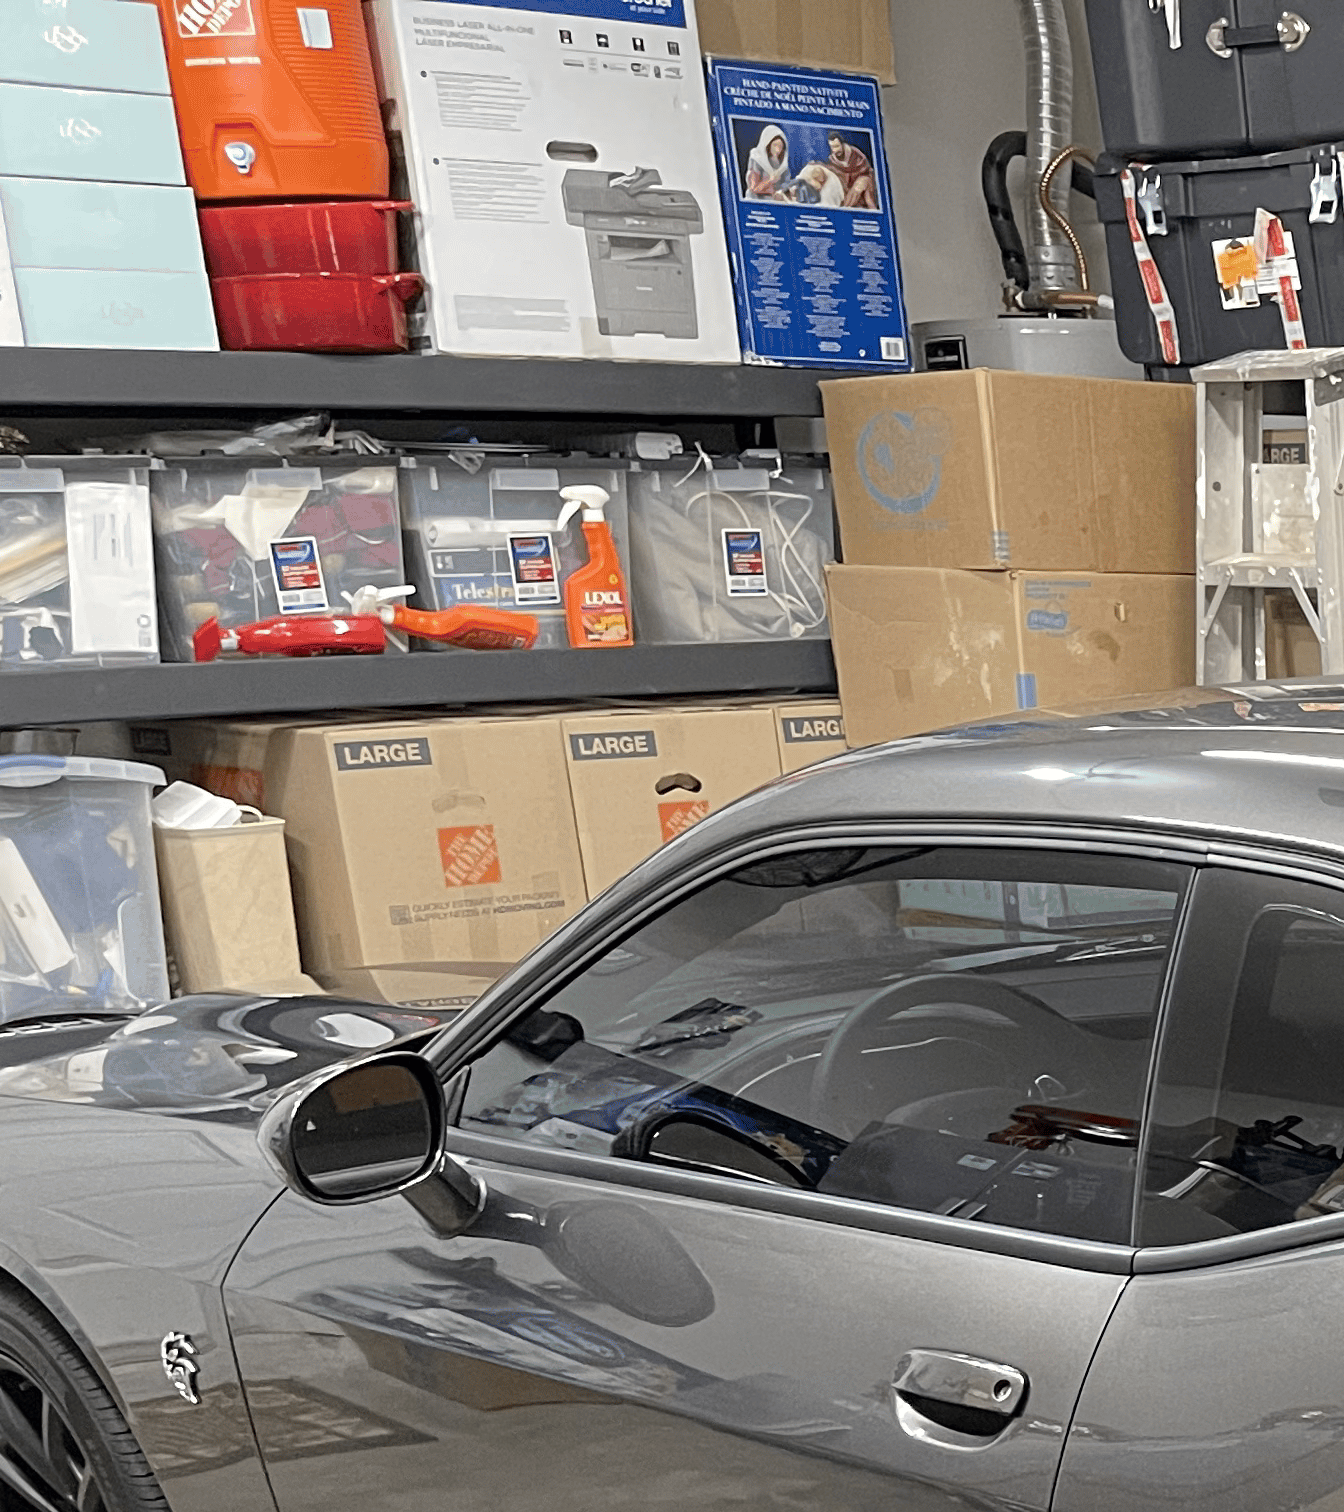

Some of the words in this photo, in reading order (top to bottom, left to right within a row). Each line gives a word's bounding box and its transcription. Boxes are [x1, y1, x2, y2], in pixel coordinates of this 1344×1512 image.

[809, 85, 849, 99] NATIVITY
[1263, 447, 1300, 464] ARGE
[584, 591, 623, 605] LEXOL
[343, 742, 423, 765] LARGE
[578, 735, 649, 756] LARGE
